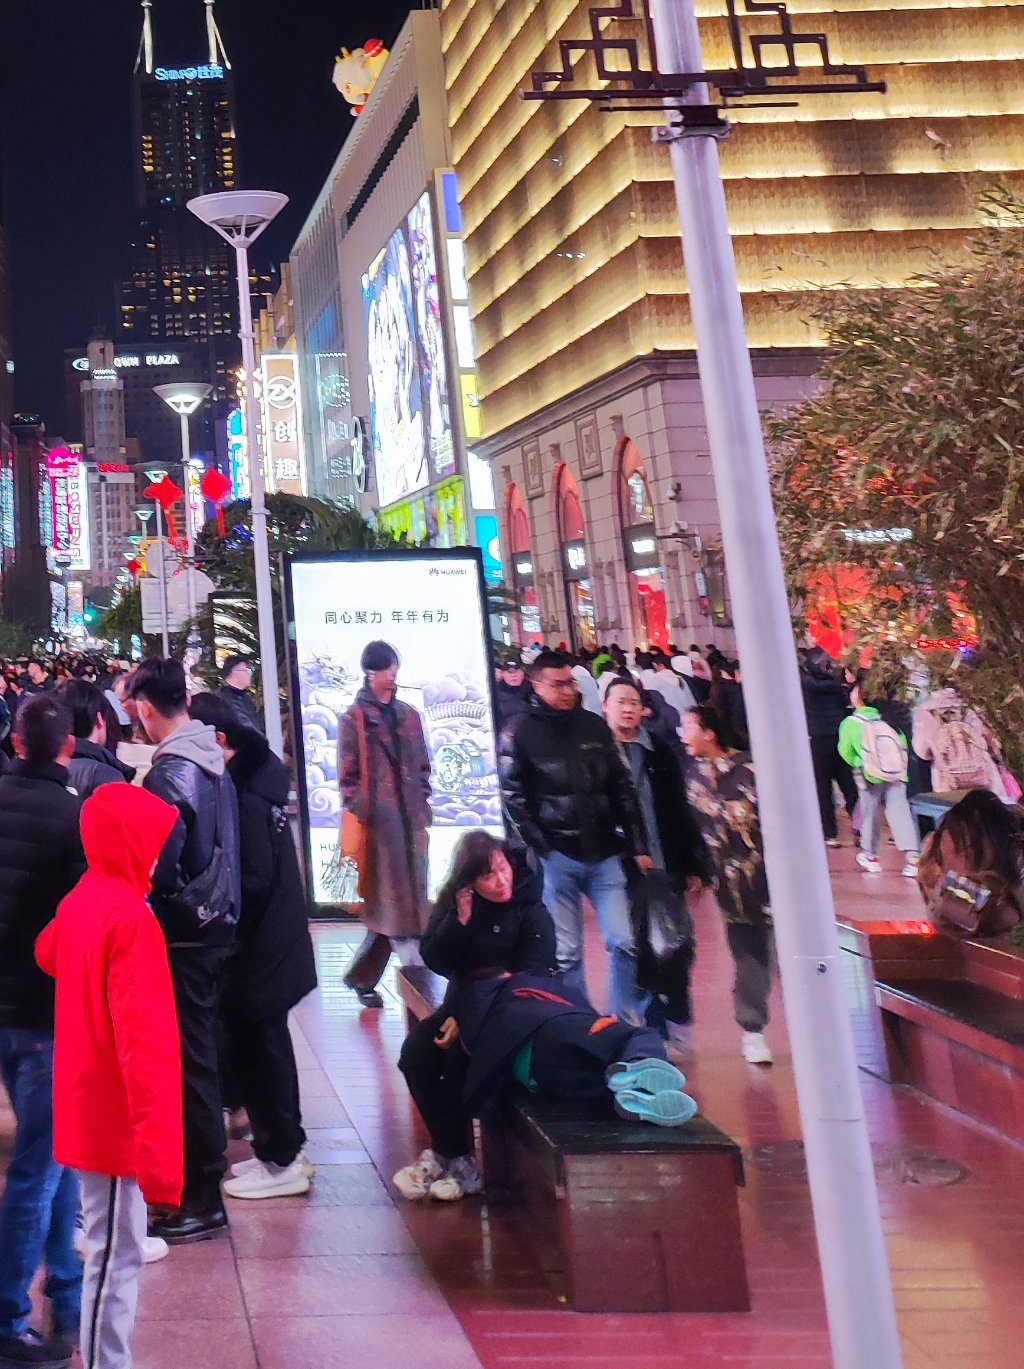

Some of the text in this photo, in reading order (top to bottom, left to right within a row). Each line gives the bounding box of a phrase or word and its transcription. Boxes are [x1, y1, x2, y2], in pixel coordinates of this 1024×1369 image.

[145, 354, 180, 366] PLAZA
[440, 568, 468, 576] HUAWEI
[324, 609, 450, 625] 同心聚力 年年有为
